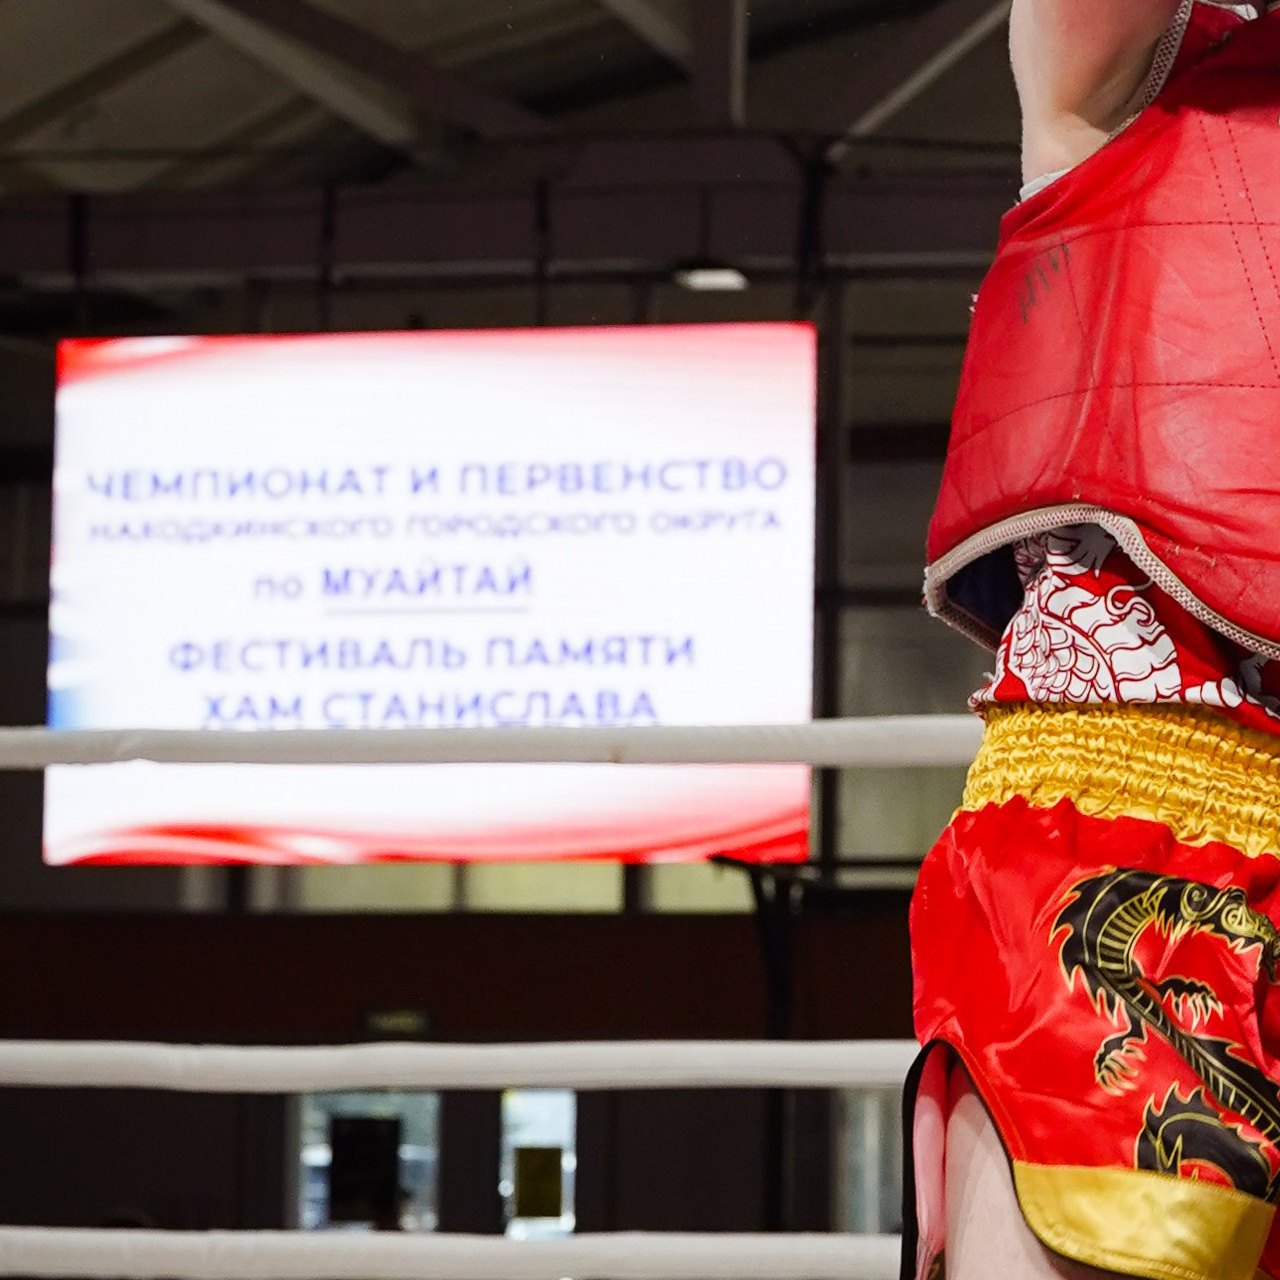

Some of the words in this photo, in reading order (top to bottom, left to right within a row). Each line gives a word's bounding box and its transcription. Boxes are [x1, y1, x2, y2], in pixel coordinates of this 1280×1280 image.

[87, 466, 387, 500] ЧЕМПИОНАТ
[411, 467, 438, 495] И
[460, 457, 788, 496] ПЕРВЕНСТВО
[254, 576, 303, 600] по
[322, 553, 532, 596] МУАЙТАЙ
[168, 637, 467, 671] ФЕСТИВАЛЬ
[486, 635, 694, 667] ПАМЯТИ
[204, 695, 303, 722] ХАМ
[322, 691, 659, 722] СТАНИСЛАВА
